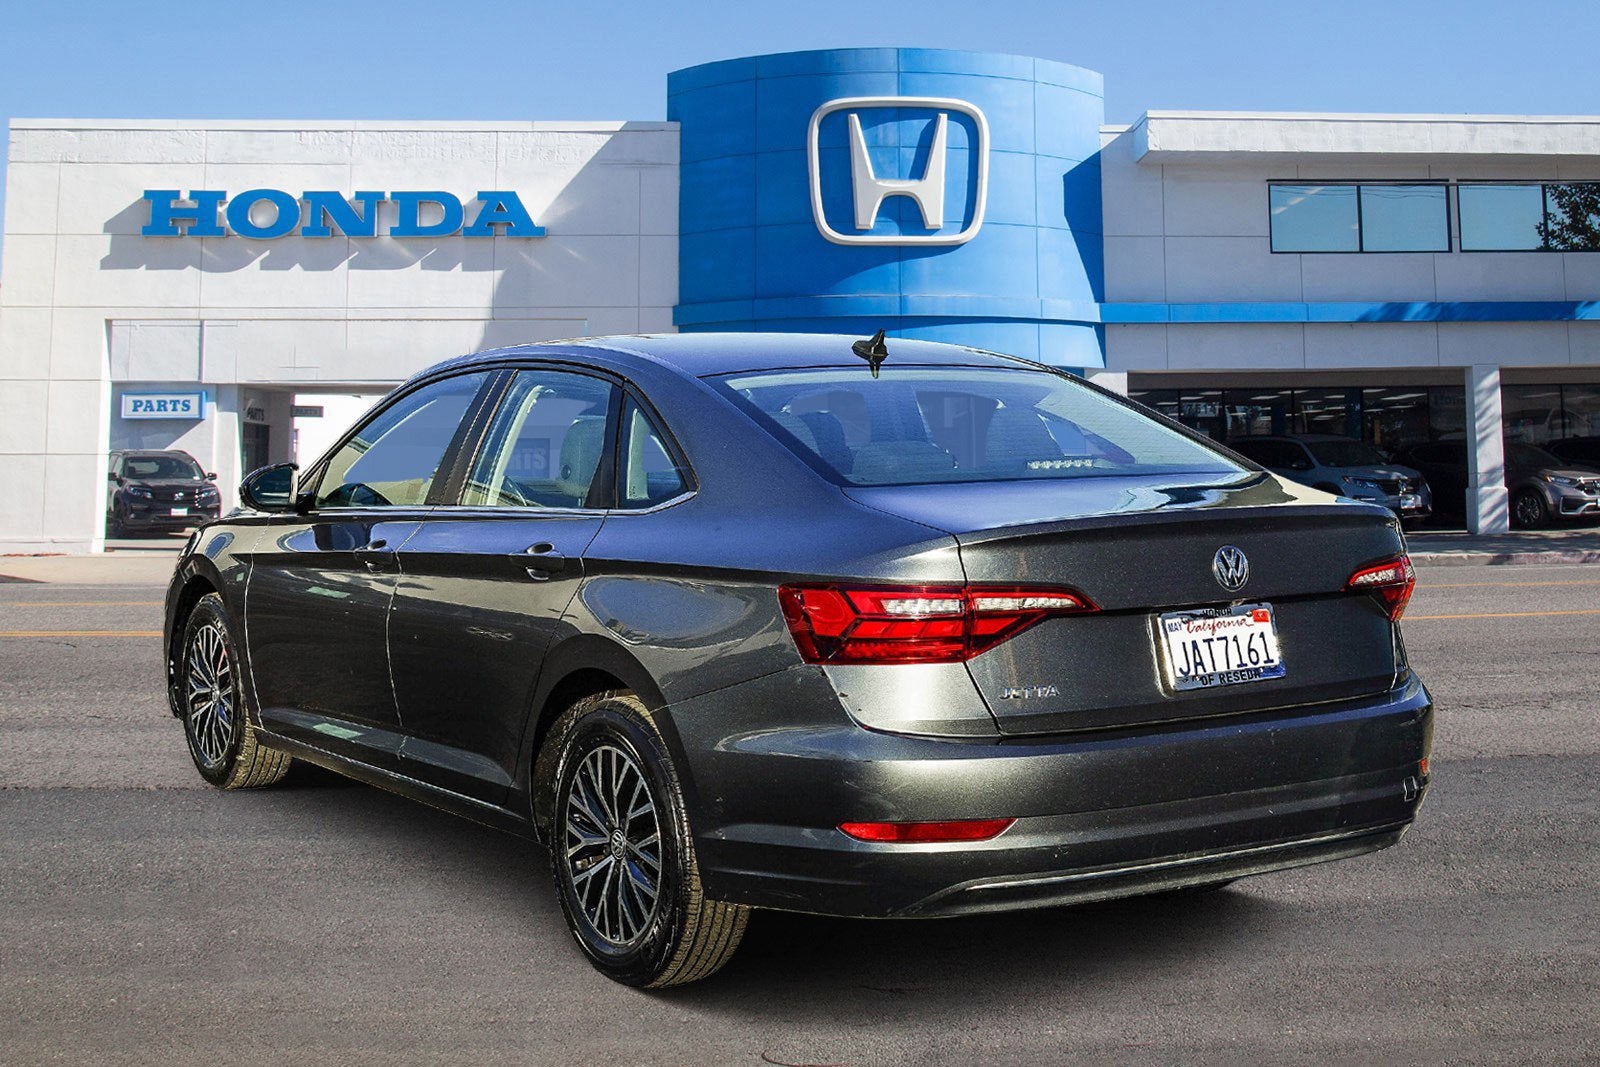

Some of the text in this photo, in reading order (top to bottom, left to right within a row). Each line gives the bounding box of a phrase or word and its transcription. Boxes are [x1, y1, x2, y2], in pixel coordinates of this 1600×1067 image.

[141, 189, 547, 240] HONDA
[132, 399, 193, 412] PARTS
[1213, 545, 1249, 592] VW
[1167, 621, 1182, 633] MAY
[1186, 617, 1255, 636] California
[1179, 631, 1275, 676] JAT7161
[1201, 669, 1261, 686] OF RESEDA
[999, 685, 1060, 700] JETTA
